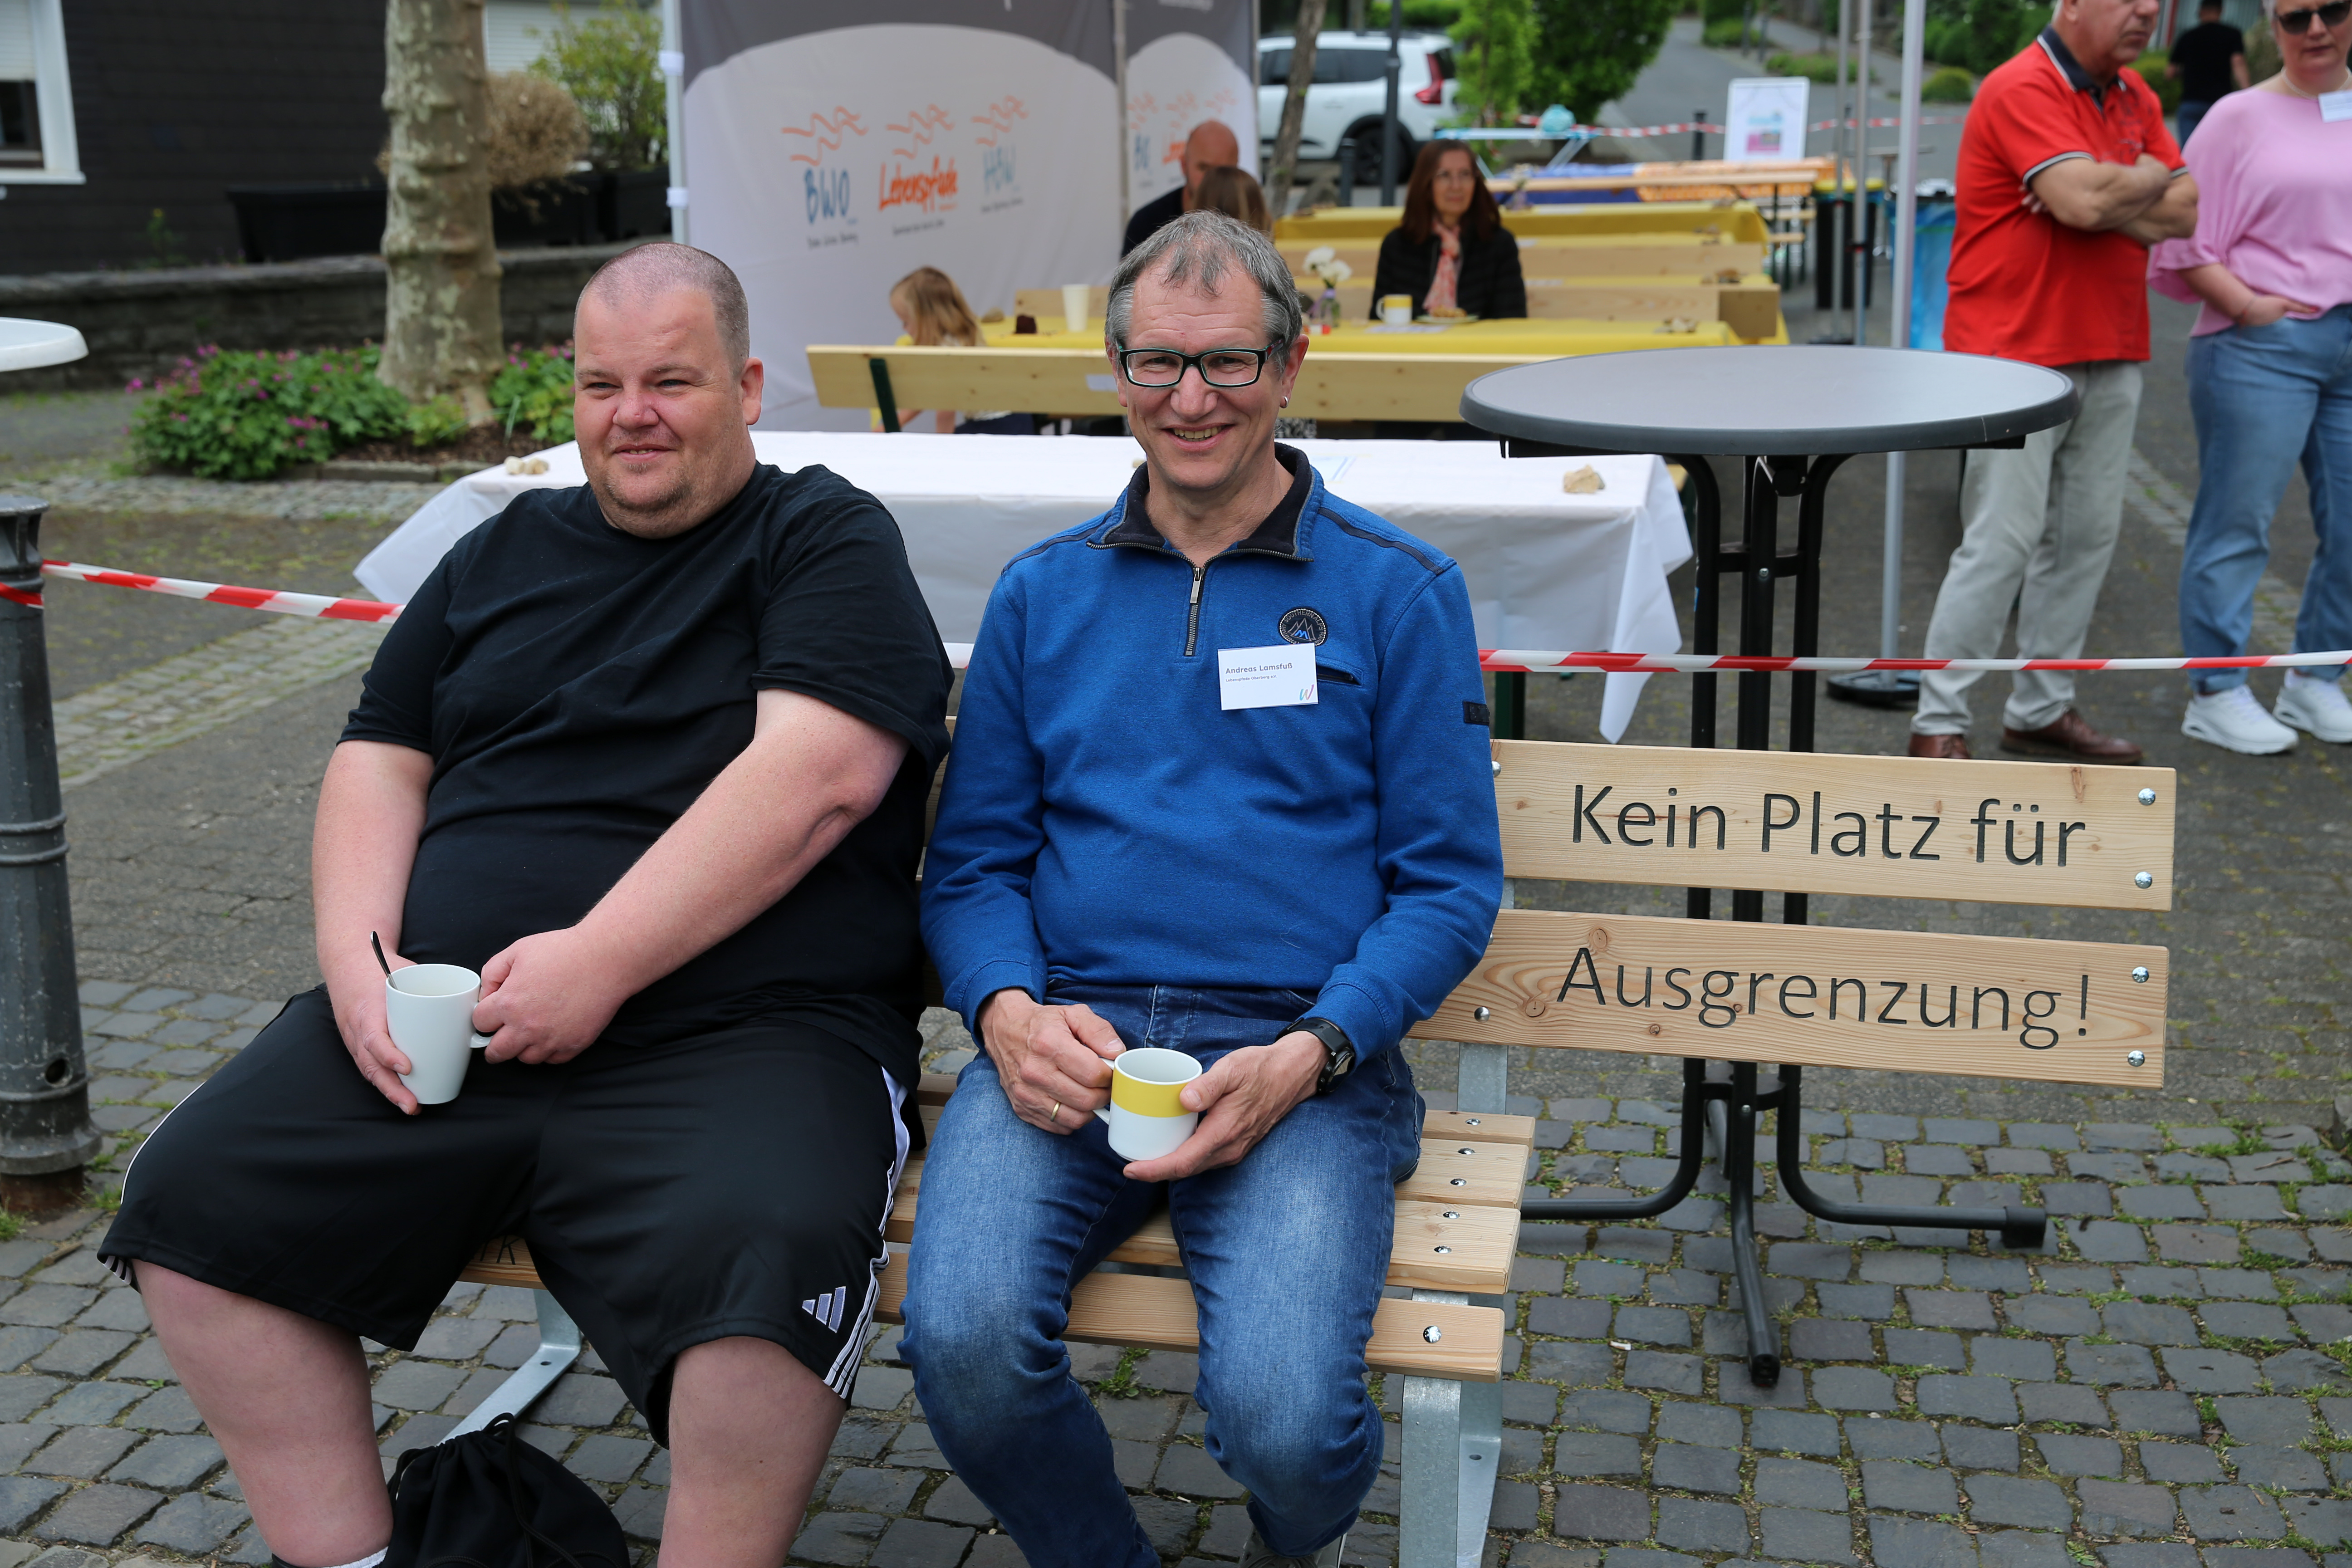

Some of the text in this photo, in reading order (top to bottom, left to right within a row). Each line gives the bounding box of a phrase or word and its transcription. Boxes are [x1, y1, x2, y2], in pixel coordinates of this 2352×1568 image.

[1259, 662, 1293, 671] Lamsfuß
[1573, 784, 2086, 867] Kein Platz für
[1557, 947, 2088, 1050] Ausgrenzung!
